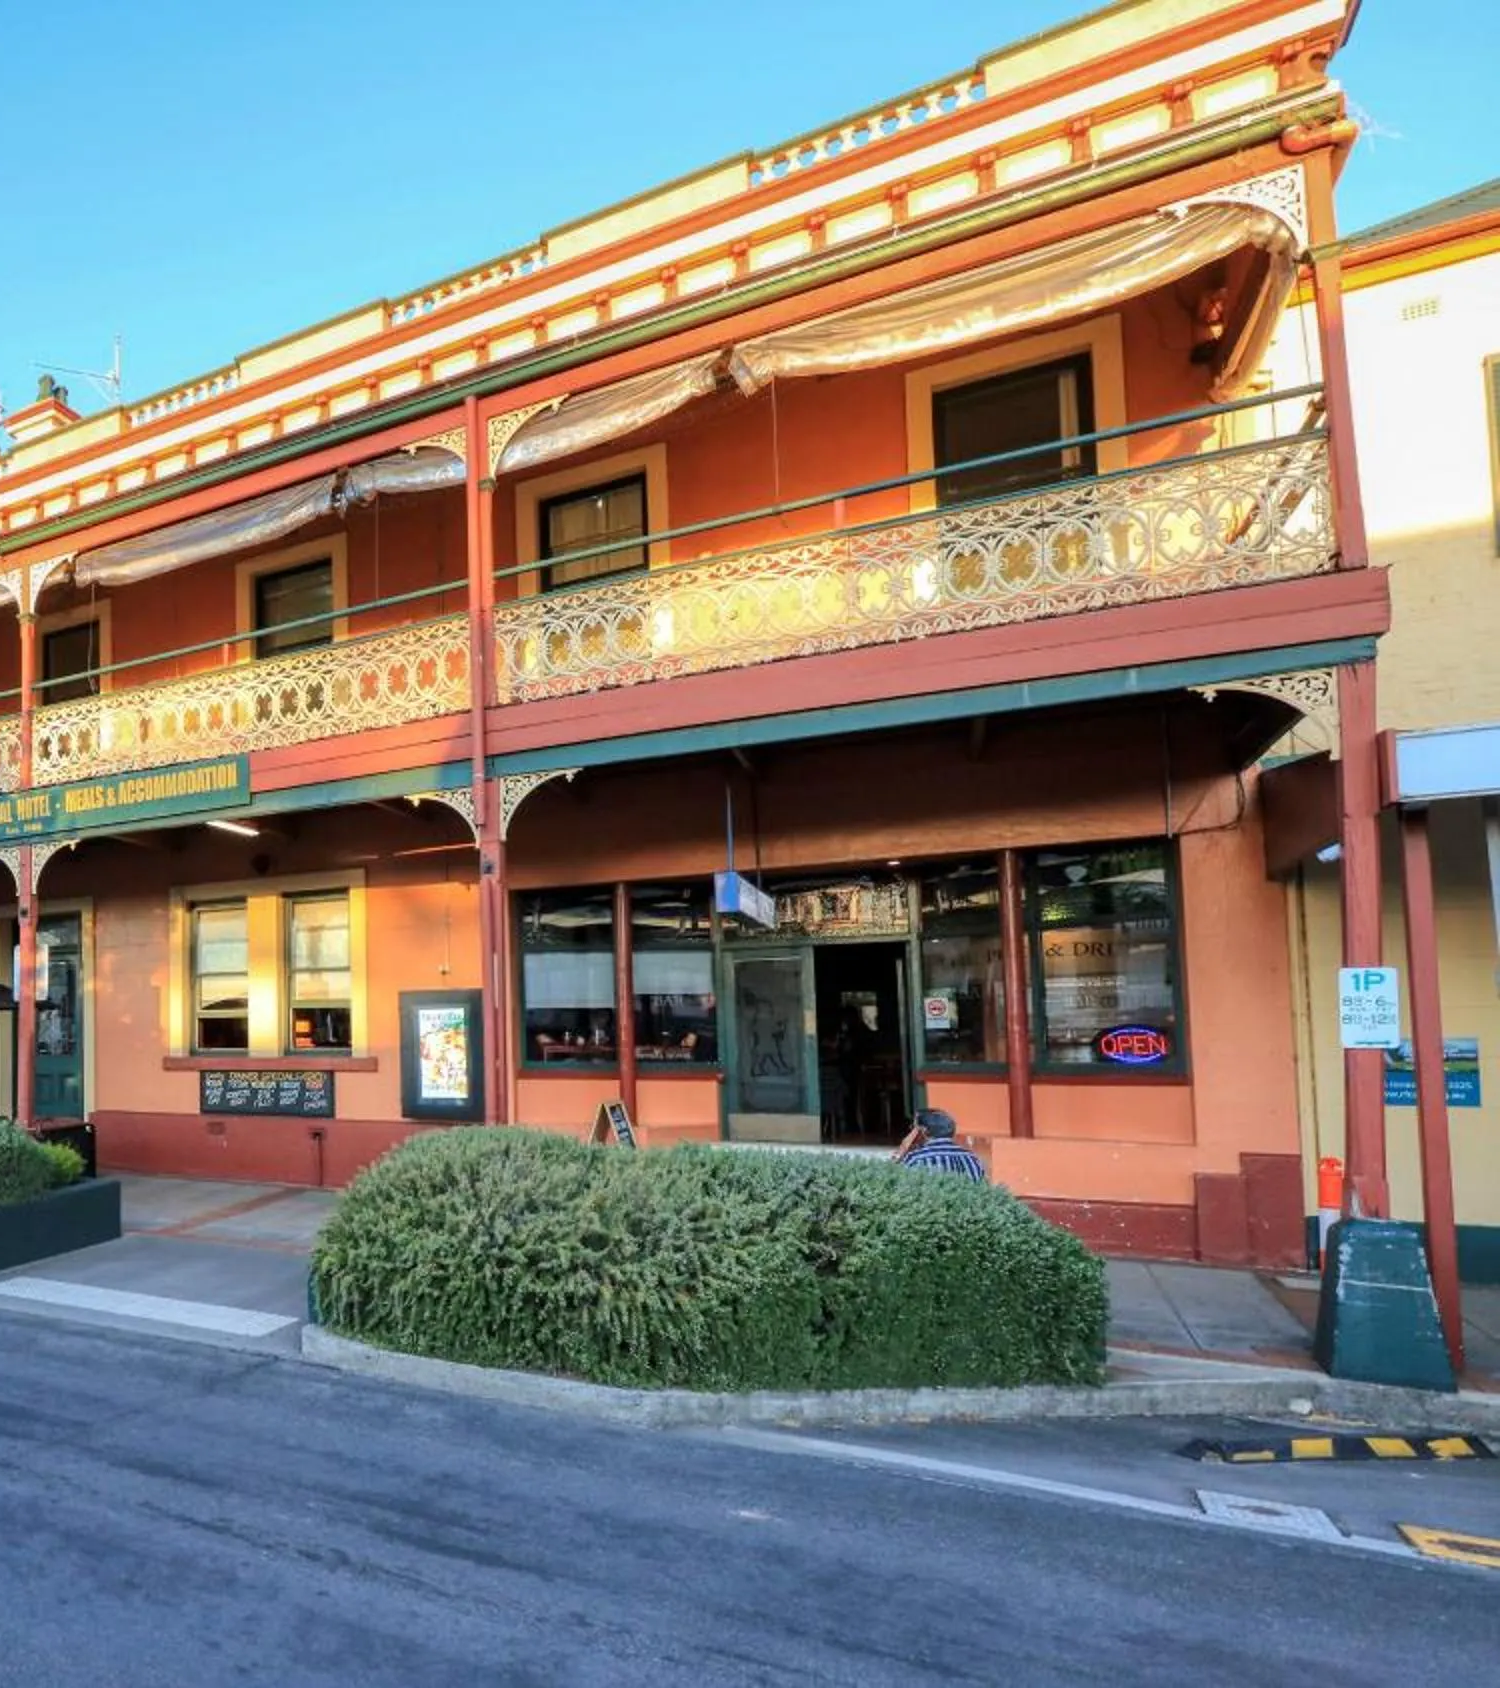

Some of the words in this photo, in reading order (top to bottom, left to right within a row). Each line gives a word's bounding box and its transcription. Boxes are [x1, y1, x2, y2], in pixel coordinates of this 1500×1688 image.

[17, 795, 51, 821] HOTEL
[65, 786, 105, 813] MEALS
[107, 788, 116, 804] &
[117, 762, 238, 804] ACCOMMODATION
[1045, 943, 1063, 957] &
[1351, 971, 1386, 992] 1P
[1101, 1035, 1168, 1056] OPEN
